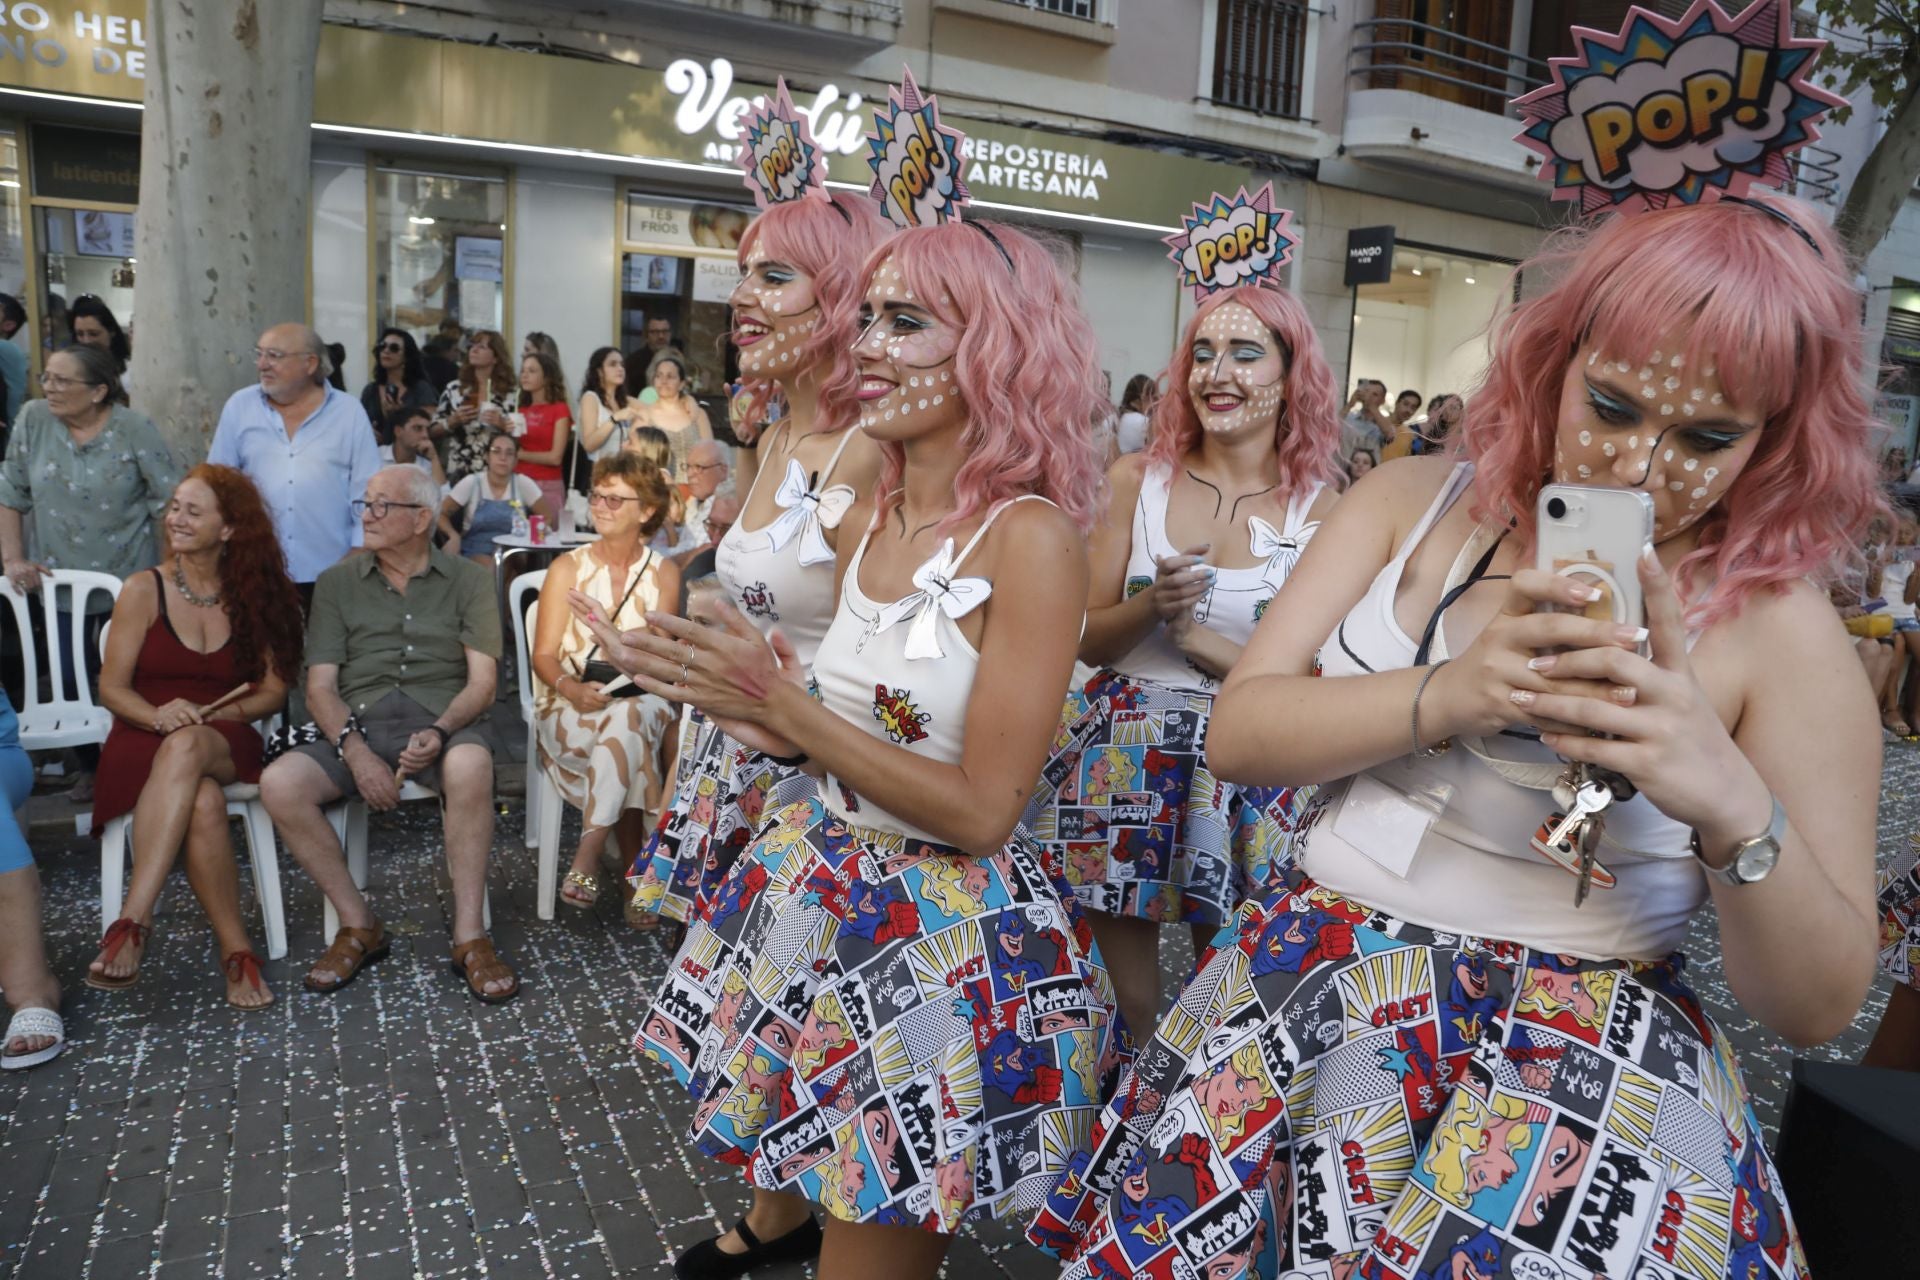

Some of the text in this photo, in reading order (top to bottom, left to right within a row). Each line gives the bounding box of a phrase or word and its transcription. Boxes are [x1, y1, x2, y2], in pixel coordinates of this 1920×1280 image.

[0, 0, 146, 47] O HEL
[92, 47, 146, 78] DE
[664, 57, 866, 155] Vedú
[1584, 48, 1774, 181] POP!
[760, 123, 801, 197] POP!
[889, 111, 943, 224] POP!
[960, 136, 1109, 180] REPOSTERÍA
[967, 162, 1099, 200] ARTESANA
[1196, 212, 1269, 282] POP!
[1350, 246, 1382, 257] MANGO
[699, 262, 739, 277] SALID
[1008, 843, 1042, 882] CITY
[946, 954, 985, 987] CRET
[662, 998, 698, 1026] CITY
[787, 1003, 808, 1021] CI
[841, 992, 864, 1029] CITY
[1044, 997, 1077, 1013] CITY
[1283, 1002, 1304, 1029] BONK
[1371, 991, 1432, 1029] CRET
[1611, 988, 1632, 1037] CITY
[1142, 1049, 1171, 1083] BONK!
[1263, 1039, 1288, 1078] CITY
[1435, 1060, 1460, 1094] BONK
[1570, 1046, 1600, 1071] BONK!
[1417, 1085, 1438, 1114] BONK
[1561, 1064, 1604, 1100] BONK!
[779, 1130, 811, 1158] CITY
[898, 1102, 932, 1149] CITY
[1152, 1112, 1177, 1139] LOOK
[1341, 1140, 1376, 1205] CRET
[1297, 1163, 1316, 1232] CITY
[1577, 1160, 1619, 1238] CITY
[1201, 1222, 1238, 1257] CITY
[1652, 1189, 1687, 1264] CRET
[1373, 1226, 1420, 1267] RET
[1521, 1256, 1560, 1280] LOOK
